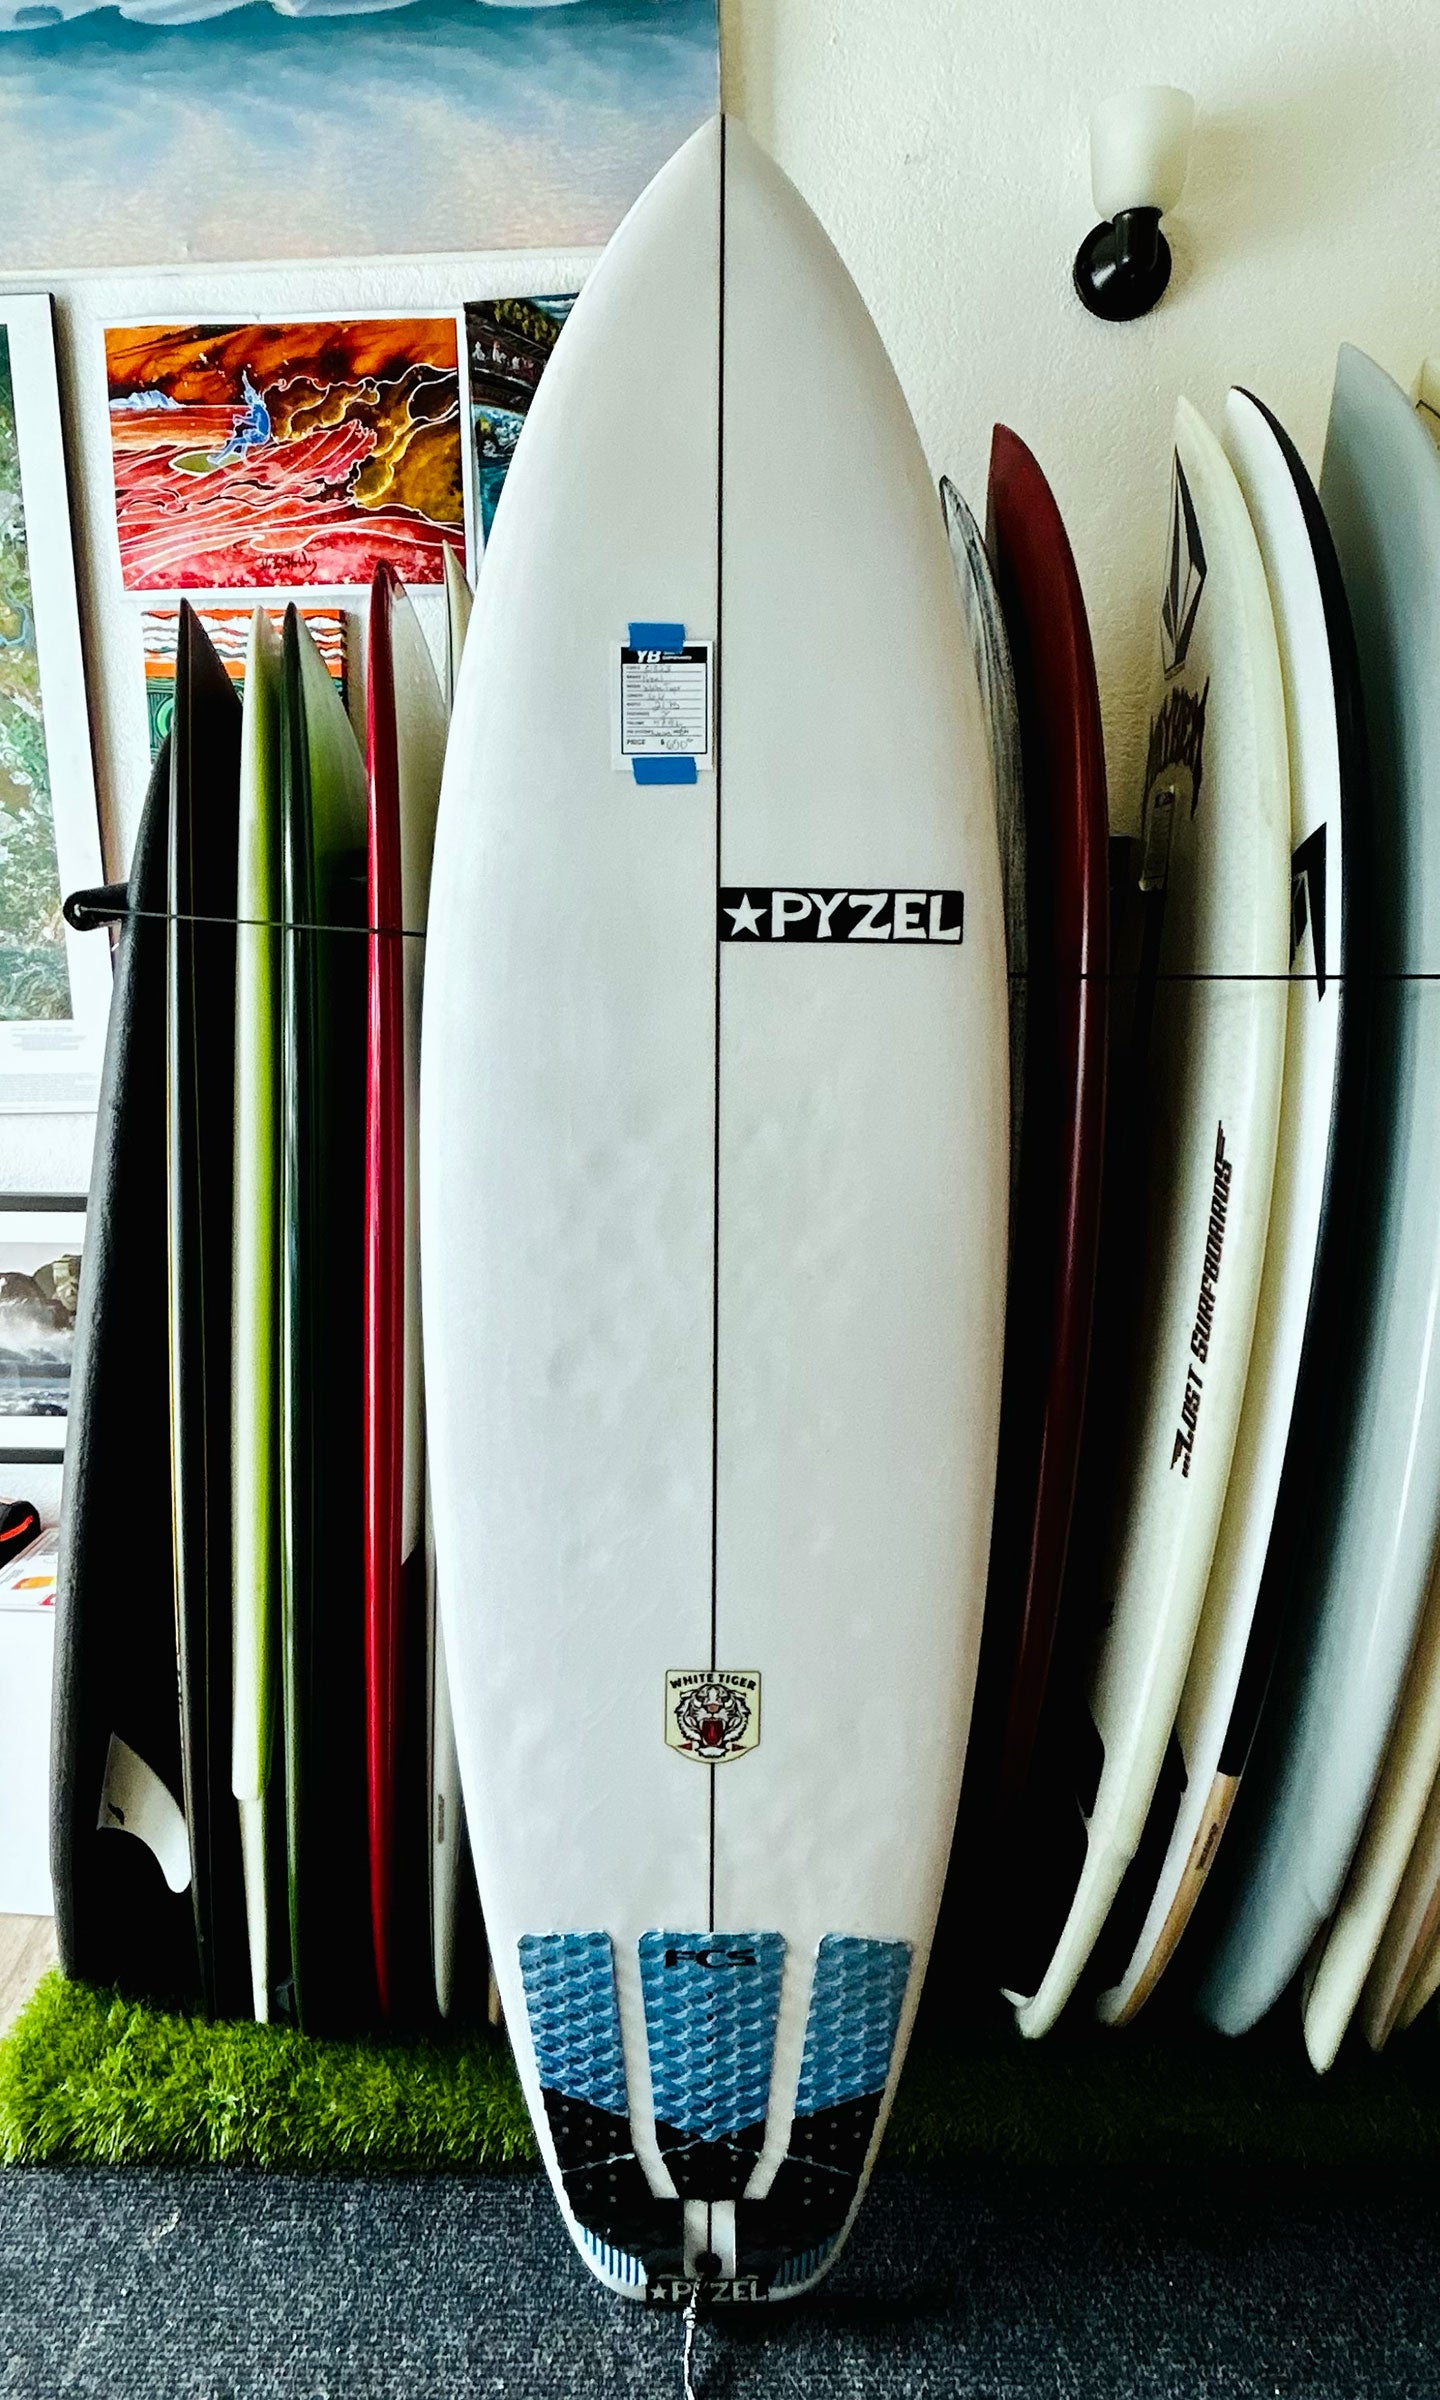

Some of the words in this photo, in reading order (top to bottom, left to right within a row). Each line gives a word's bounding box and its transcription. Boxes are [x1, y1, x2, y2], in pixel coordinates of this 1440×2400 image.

[771, 891, 961, 940] PYZEL
[1190, 1121, 1232, 1364] SURFBOARDS
[669, 1673, 714, 1689] WHITE
[718, 1673, 757, 1691] TIGER
[665, 1948, 757, 1969] FCS
